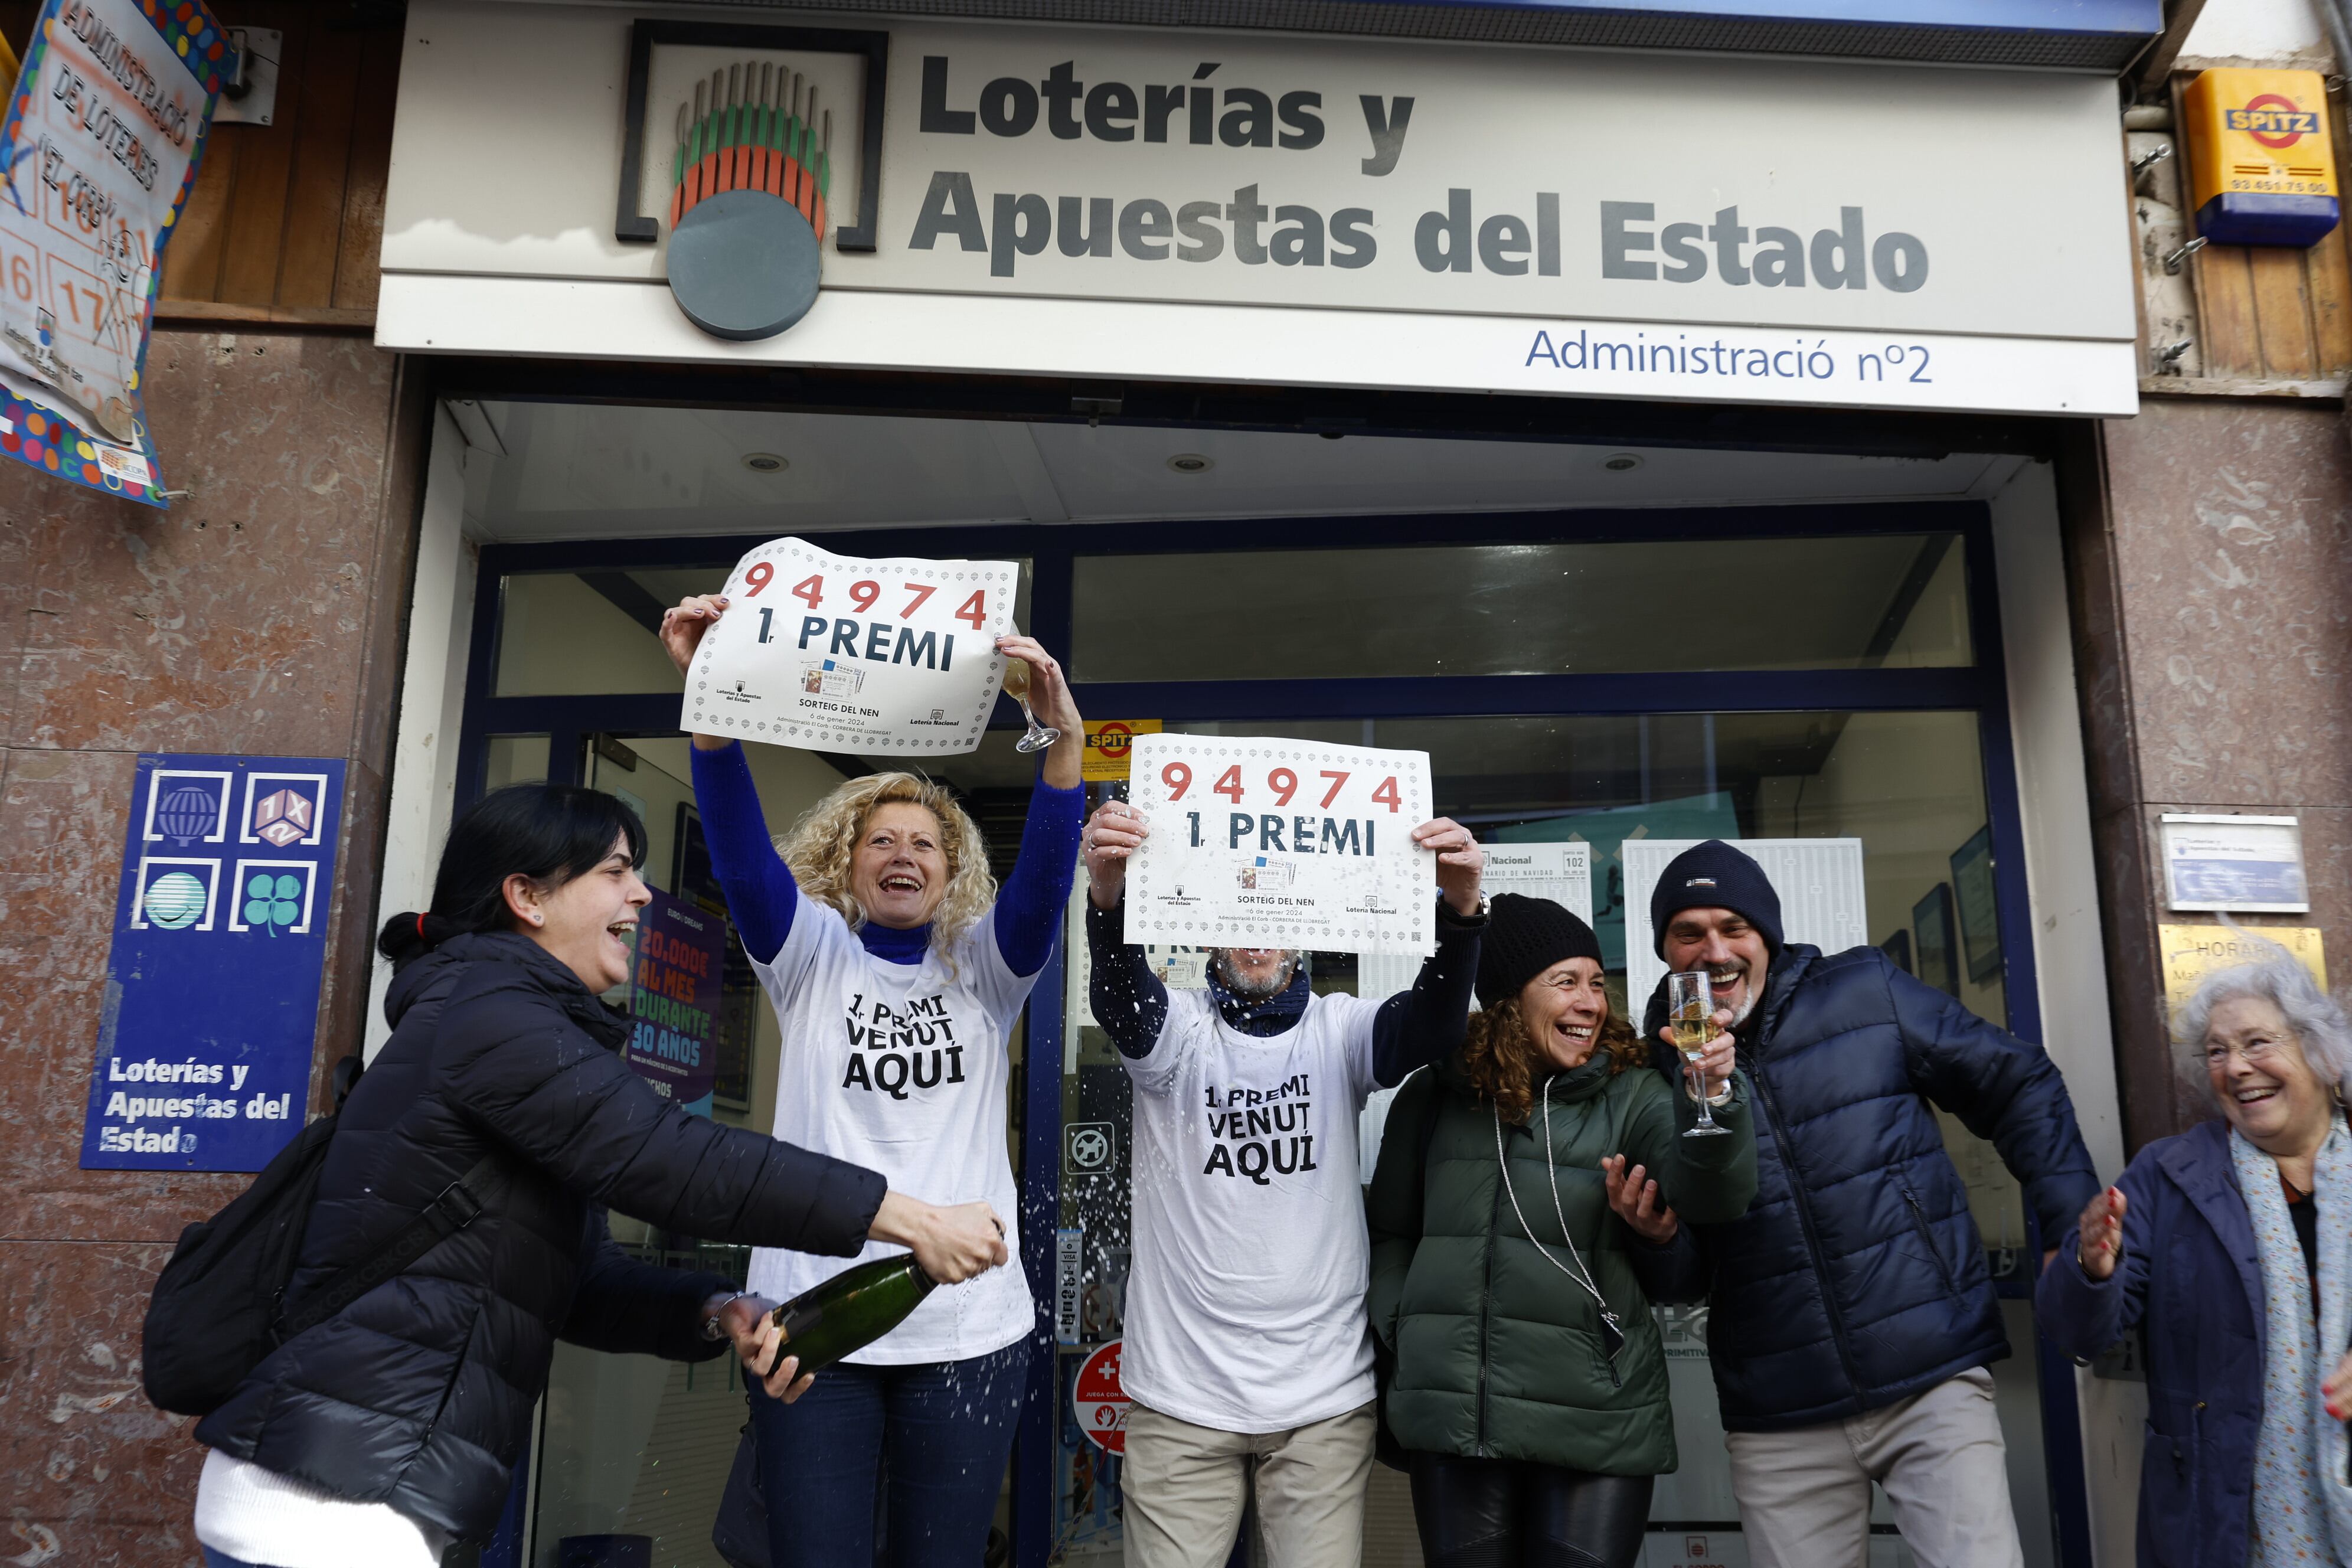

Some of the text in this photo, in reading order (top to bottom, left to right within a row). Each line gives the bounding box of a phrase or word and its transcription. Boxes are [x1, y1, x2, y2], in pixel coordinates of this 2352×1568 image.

[62, 1, 189, 146] ADMINISTRACIÓ
[53, 63, 158, 192] DE LOTERIES
[919, 55, 1415, 177] Loterías y
[2231, 110, 2314, 132] SPITZ
[2232, 179, 2250, 190] 93
[2254, 181, 2281, 191] 451
[2286, 182, 2305, 192] 75
[907, 171, 1929, 293] Apuestas del Estado
[60, 280, 103, 331] 17
[1524, 328, 1834, 380] Administració
[798, 615, 954, 672] PREMI
[777, 716, 810, 726] Administració
[799, 699, 879, 717] SORTEIG DEL NEN
[1229, 813, 1374, 857] PREMI
[1491, 856, 1531, 864] Nacional
[1566, 858, 1583, 867] 102
[1237, 896, 1275, 904] SORTEIG
[640, 925, 709, 978] 20.000€
[637, 958, 695, 1004] AL MES
[635, 987, 711, 1039] DURANTE
[845, 1018, 953, 1050] VENUT
[632, 1021, 701, 1067] 30 AÑOS
[109, 1057, 250, 1090] Loterías y
[842, 1041, 965, 1100] AQUÍ
[1228, 1074, 1310, 1108] PREMI
[104, 1092, 291, 1123] Apuestas del
[1208, 1102, 1310, 1139] VENUT
[99, 1126, 198, 1153] Estado
[1203, 1130, 1317, 1185] AQUÍ
